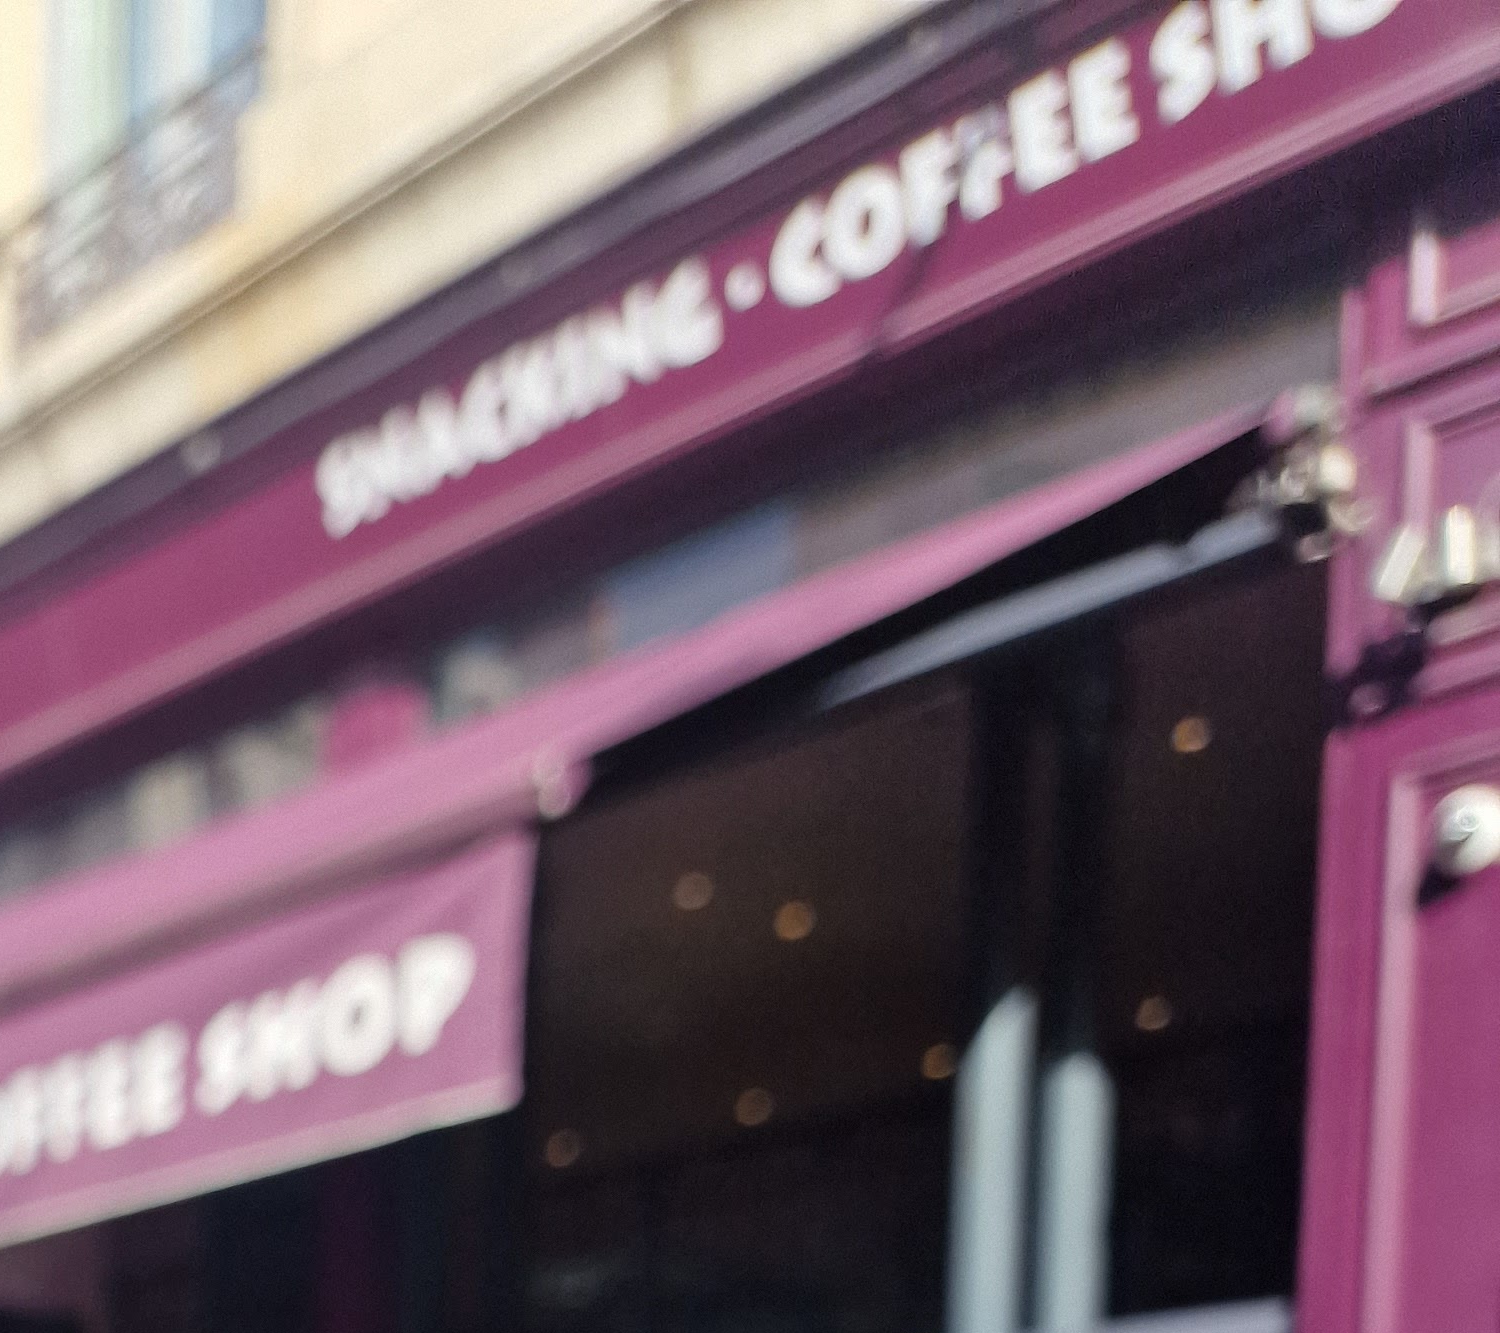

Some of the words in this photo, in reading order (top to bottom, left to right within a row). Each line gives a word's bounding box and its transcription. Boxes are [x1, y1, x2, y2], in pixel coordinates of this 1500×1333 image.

[318, 262, 721, 533] SNACKING
[769, 42, 1138, 306] COFFEE
[194, 933, 478, 1116] SHOP
